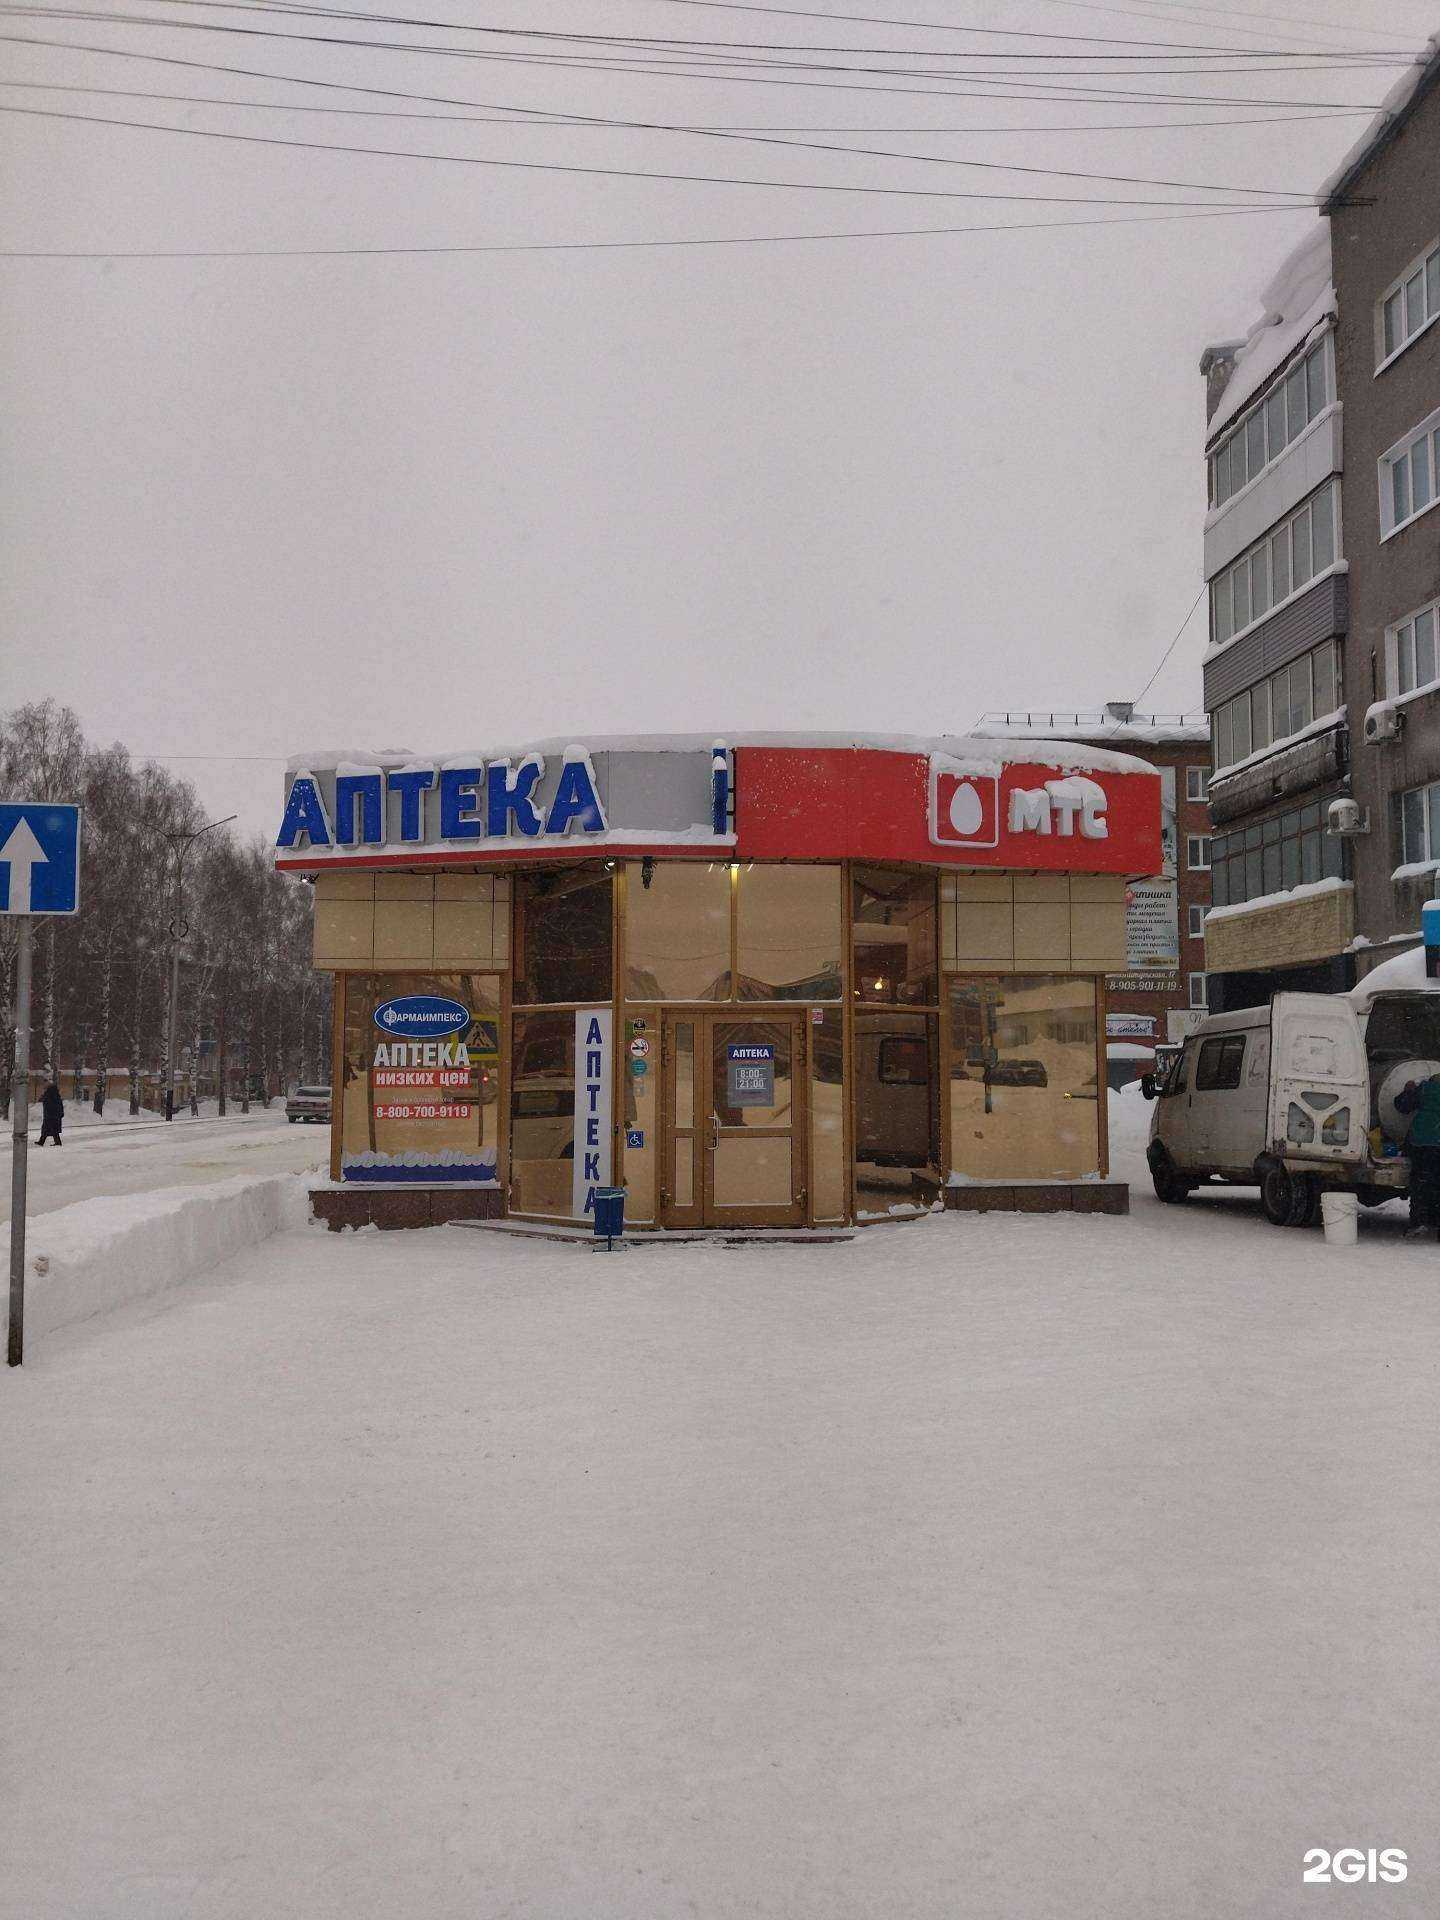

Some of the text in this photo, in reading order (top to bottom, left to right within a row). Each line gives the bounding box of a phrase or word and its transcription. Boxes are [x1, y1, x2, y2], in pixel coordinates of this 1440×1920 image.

[275, 757, 606, 848] АПТЕКА
[1008, 778, 1109, 839] МТС
[383, 1006, 462, 1026] ФАРМАИМПЕКС
[373, 1042, 471, 1068] АПТЕКА
[732, 1048, 770, 1058] АПТЕКА
[376, 1072, 469, 1086] низких цен
[376, 1105, 468, 1118] 8-800-700-9119
